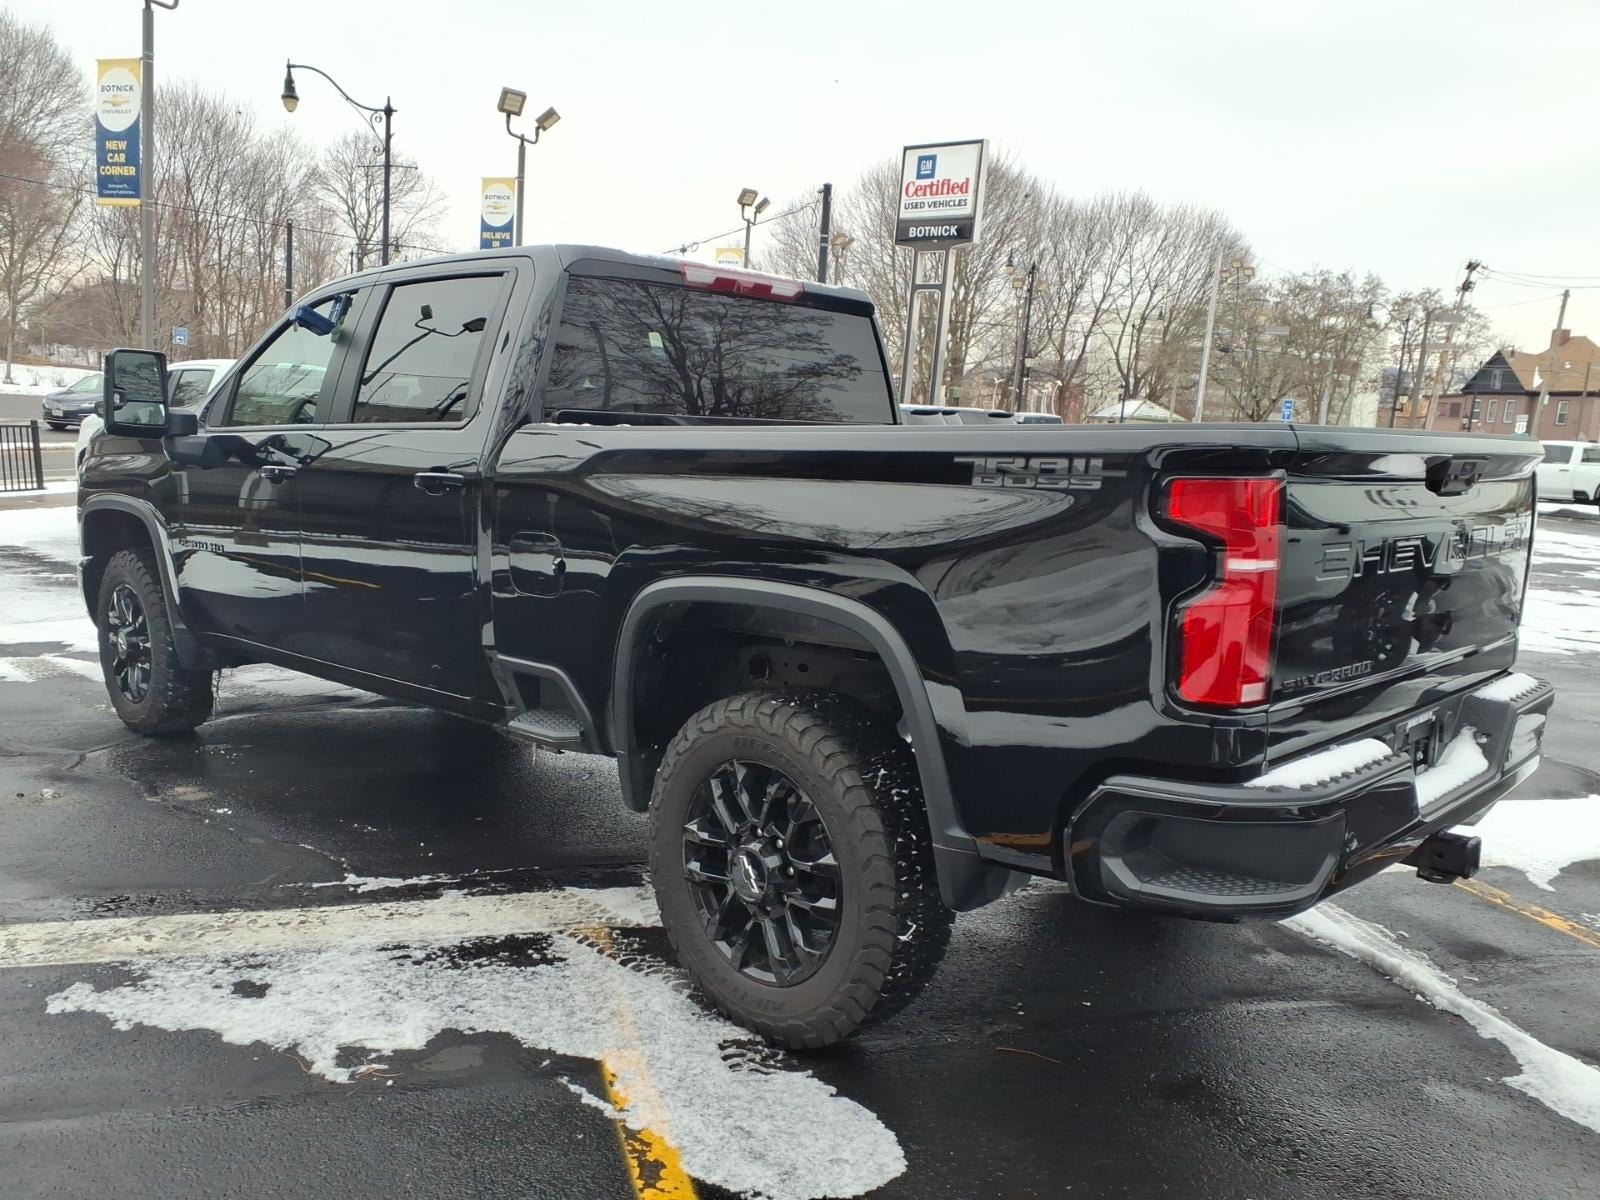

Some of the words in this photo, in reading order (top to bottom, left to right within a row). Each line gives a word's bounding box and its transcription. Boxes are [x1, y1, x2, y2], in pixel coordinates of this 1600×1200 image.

[100, 84, 135, 93] BOTNICK
[105, 140, 127, 150] NEW
[107, 152, 126, 163] CAR
[99, 165, 136, 176] CORNER
[920, 159, 933, 171] GM
[904, 177, 970, 198] Certified
[904, 200, 926, 210] USED
[927, 198, 968, 209] VEHICLES
[482, 231, 511, 240] BELIEVE
[908, 224, 958, 238] BOTNICK
[492, 240, 501, 248] IN
[953, 456, 1128, 478] TRAIL
[970, 474, 1103, 491] BOSS
[1281, 659, 1375, 694] SILVERADO
